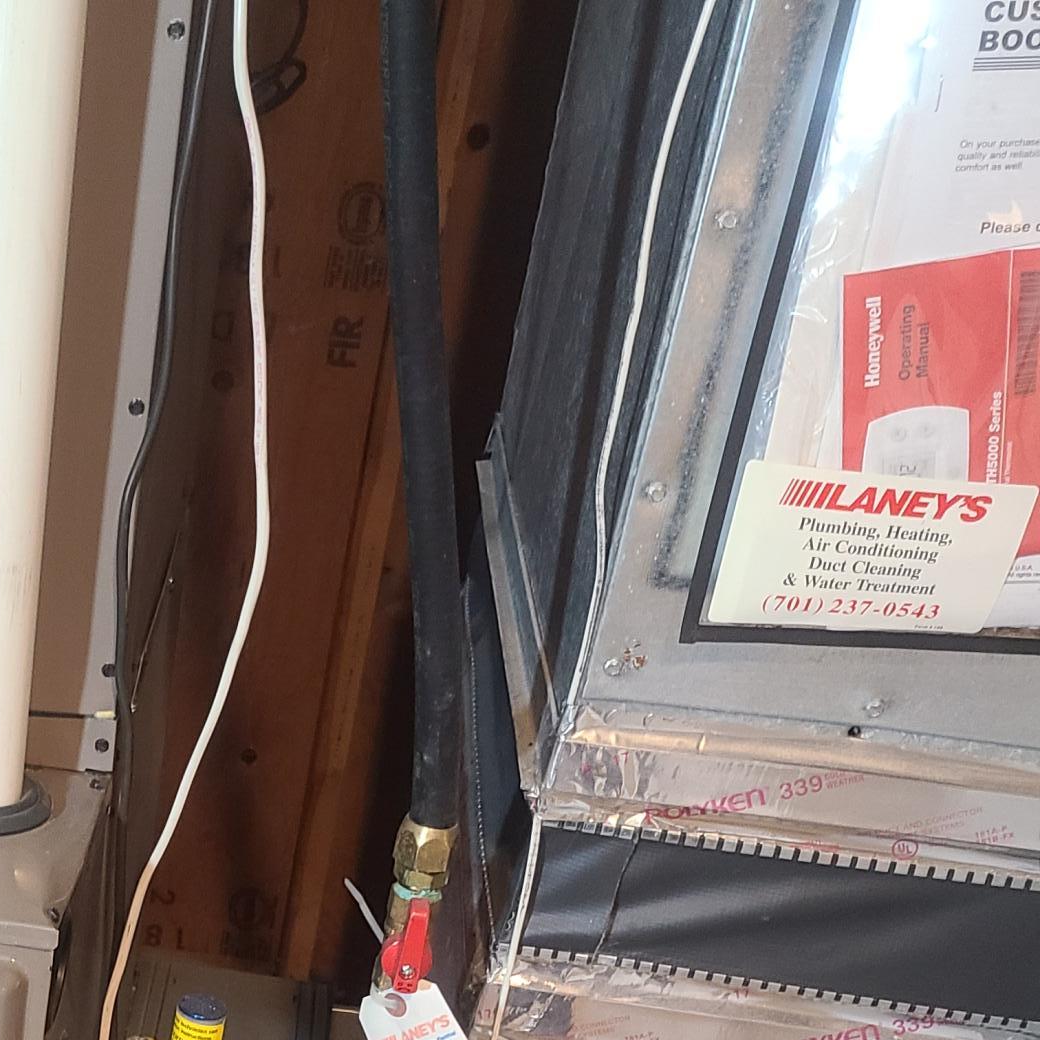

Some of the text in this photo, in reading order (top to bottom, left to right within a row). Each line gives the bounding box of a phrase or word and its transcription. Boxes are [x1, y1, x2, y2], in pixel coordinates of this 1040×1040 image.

[957, 152, 986, 161] quality
[990, 151, 1007, 160] and
[976, 140, 996, 150] your
[955, 163, 988, 172] comfort
[980, 221, 1031, 234] Please
[326, 316, 364, 368] FIR
[864, 296, 884, 388] Honeywell
[898, 304, 916, 382] Operating
[916, 322, 930, 378] Manual
[988, 391, 1002, 433] Series
[823, 483, 992, 523] LANEY'S
[798, 516, 953, 546] Plumbing, Heating,
[802, 537, 939, 564] Air Conditioning
[808, 556, 922, 580] Duct Cleaning
[782, 573, 936, 596] & Water Treatment
[762, 594, 940, 620] (701) 237-0543
[780, 775, 822, 800] 339
[892, 1016, 934, 1038] 339
